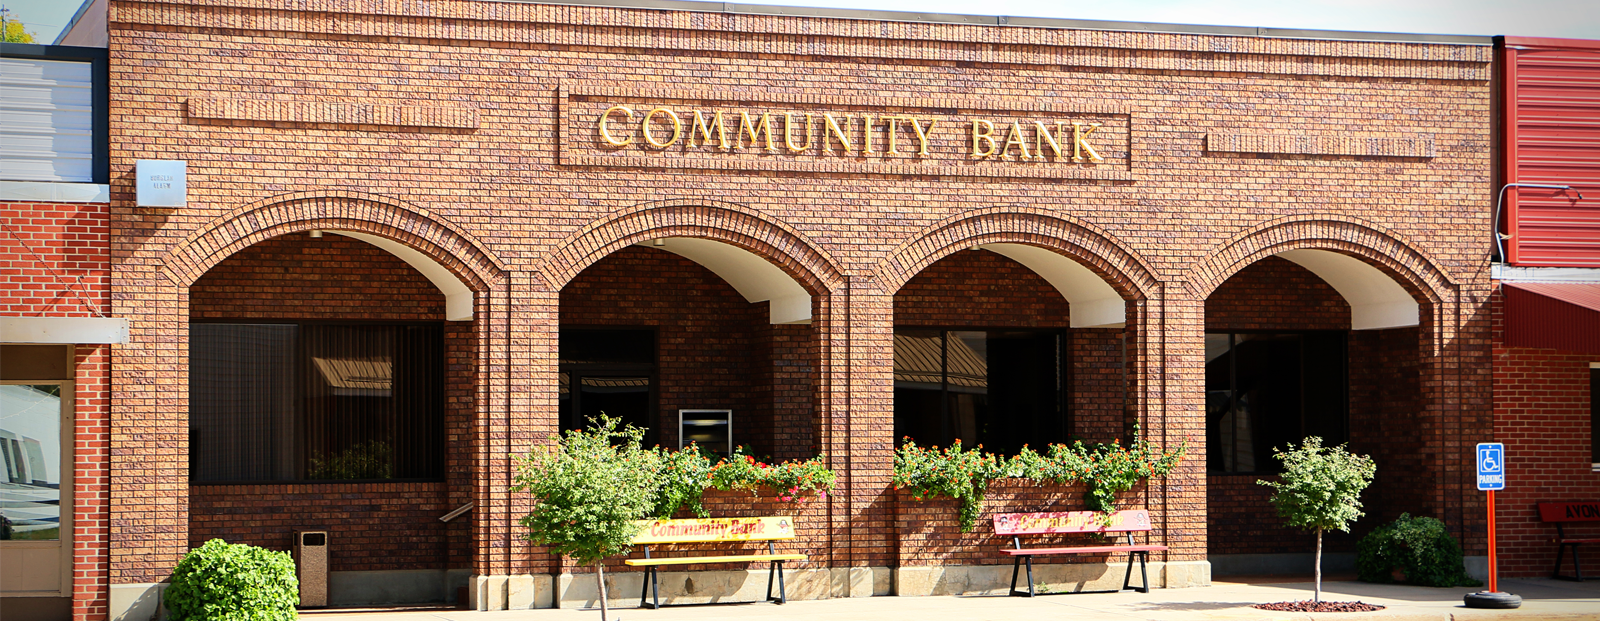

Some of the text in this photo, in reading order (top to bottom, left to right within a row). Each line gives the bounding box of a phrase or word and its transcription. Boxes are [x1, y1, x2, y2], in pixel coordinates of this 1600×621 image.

[599, 105, 1104, 161] COMMUNITY BANK
[1479, 474, 1502, 484] PARKING
[1565, 504, 1600, 518] AVON
[651, 519, 765, 538] Community Bank
[1020, 514, 1091, 530] Community
